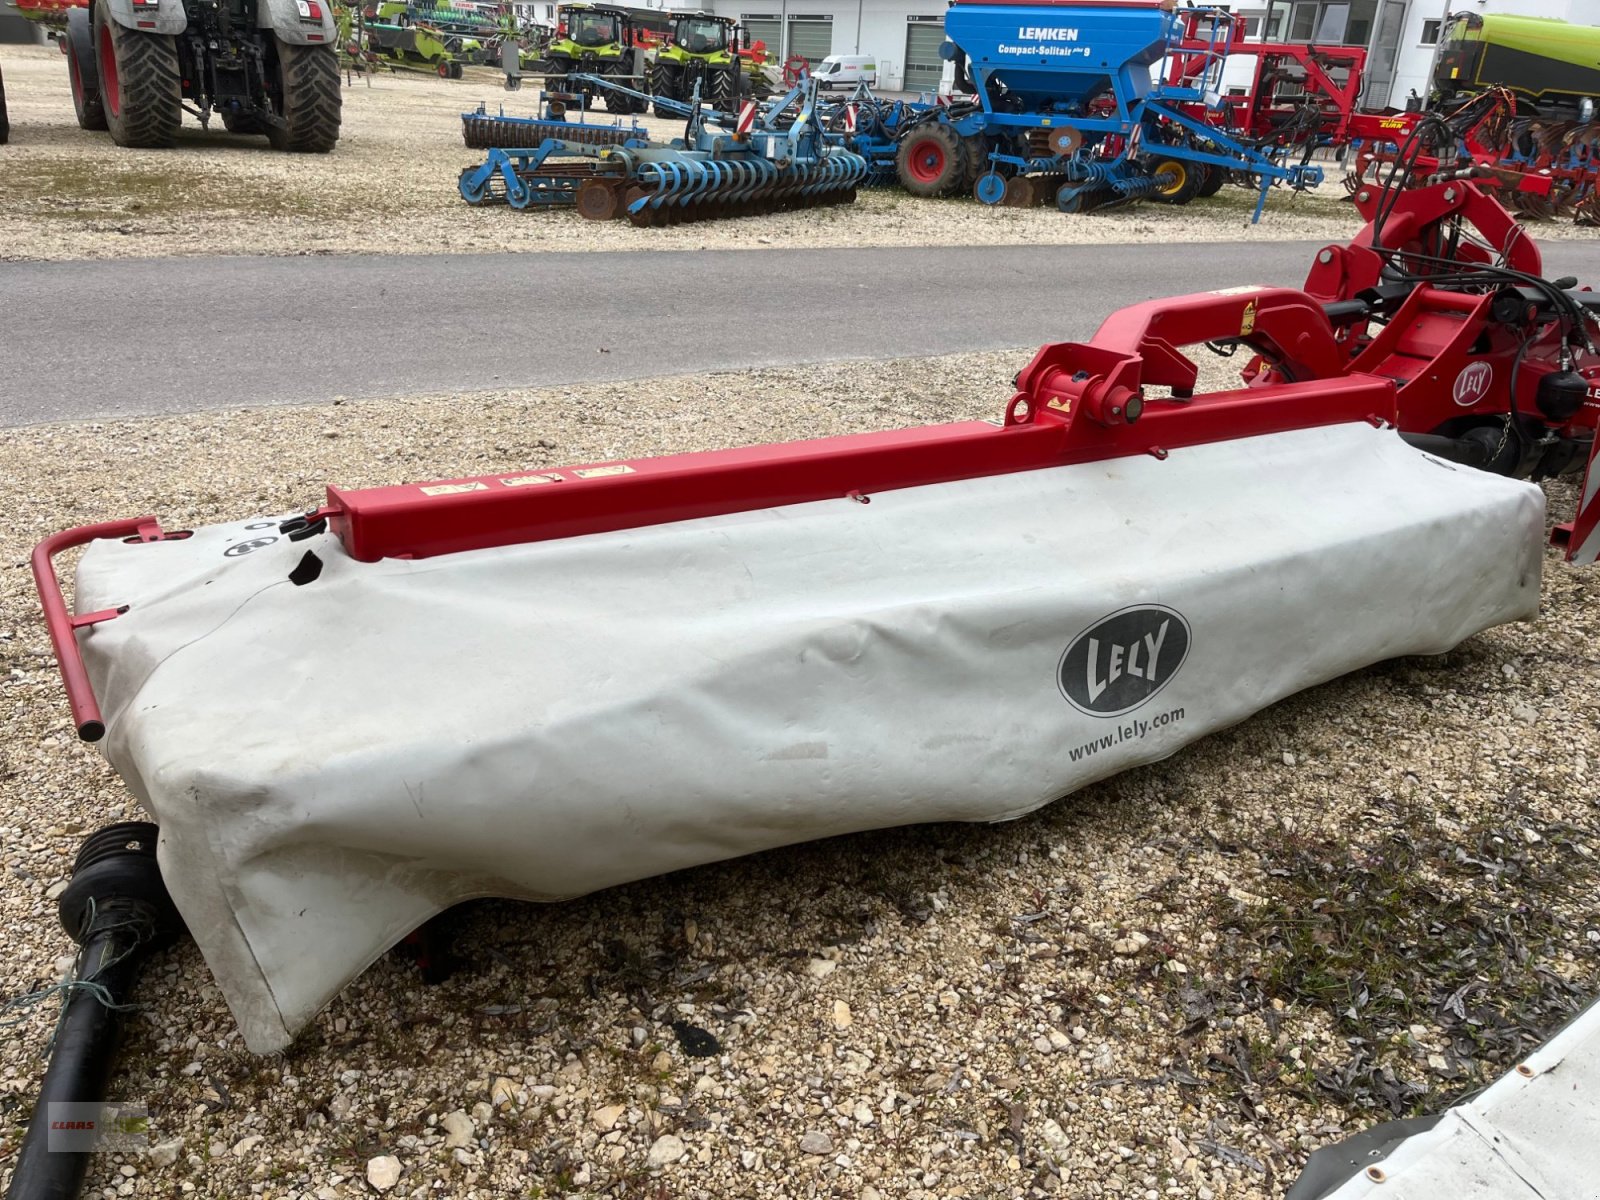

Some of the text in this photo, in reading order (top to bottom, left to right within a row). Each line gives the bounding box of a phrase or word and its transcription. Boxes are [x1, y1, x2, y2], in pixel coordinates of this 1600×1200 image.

[1018, 27, 1079, 42] LEMKEN
[998, 44, 1072, 56] Compact-Solitair
[1083, 47, 1091, 57] 9
[1458, 368, 1487, 399] LELY
[1086, 618, 1170, 705] LELY
[1068, 707, 1186, 762] www.lely.com
